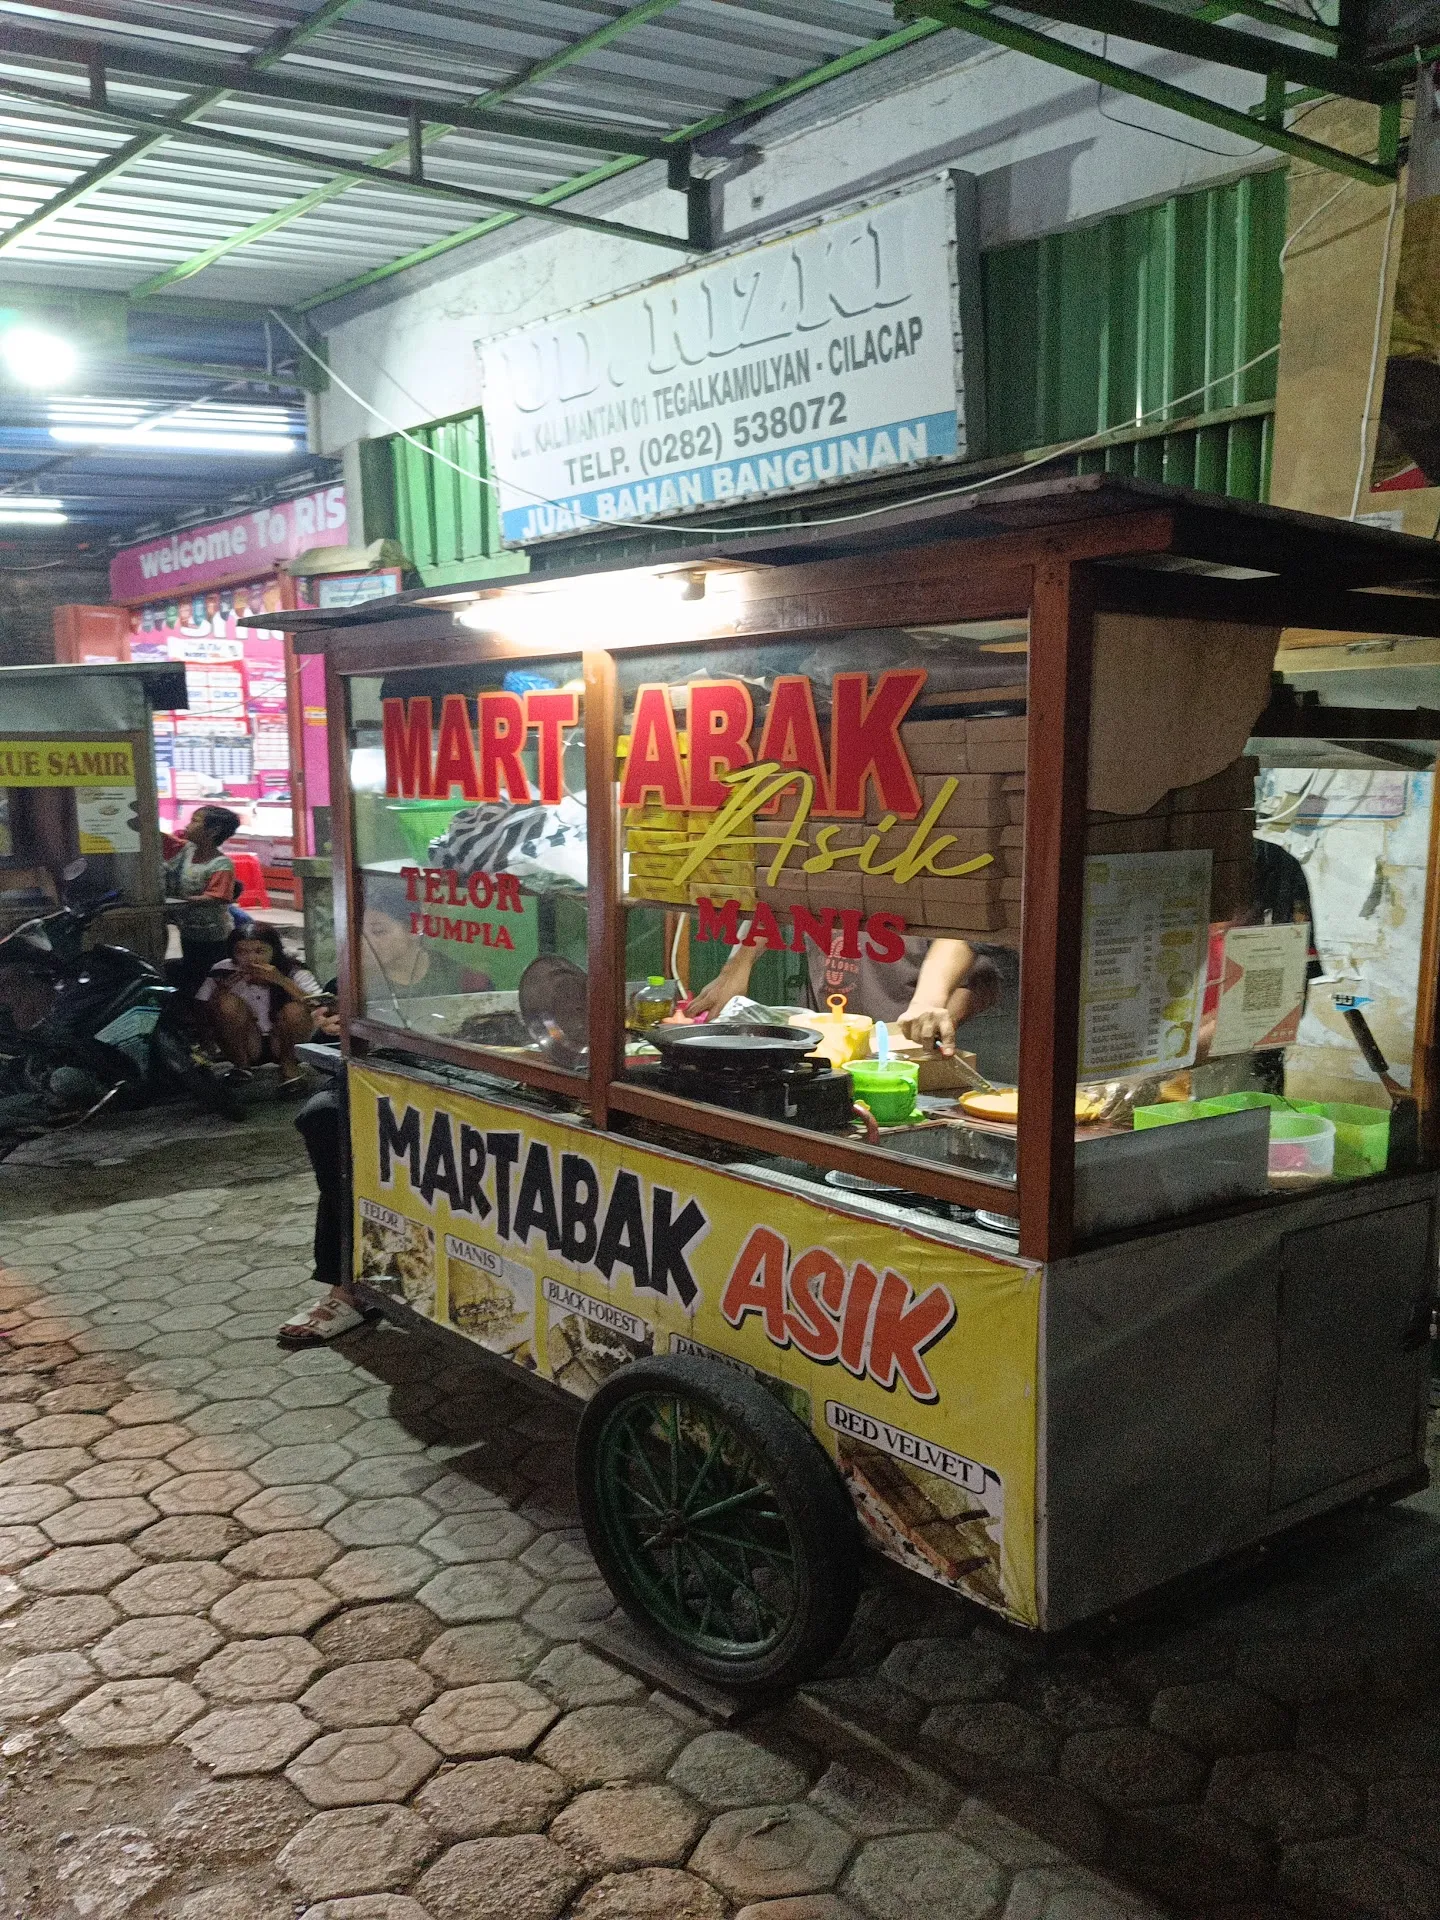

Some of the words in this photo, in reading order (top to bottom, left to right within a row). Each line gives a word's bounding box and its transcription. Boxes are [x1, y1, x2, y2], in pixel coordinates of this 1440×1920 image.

[652, 347, 811, 421] TEGALKAMULYAN
[828, 316, 923, 376] CILACAP
[564, 446, 630, 486] TELP.
[639, 422, 723, 476] (0282)
[733, 391, 847, 448] 538072
[522, 500, 590, 538] JUAL
[597, 473, 705, 522] BAHAN
[711, 422, 929, 500] BANGUNAN
[252, 508, 287, 548] To
[0, 750, 41, 777] UE
[47, 750, 131, 777] SAMIR
[658, 761, 995, 888] Asik
[399, 866, 524, 914] TELOR
[696, 897, 906, 964] MANIS
[363, 1201, 399, 1228] TELOR
[375, 1095, 708, 1308] MARTABAK
[720, 1222, 958, 1401] ASIK
[449, 1238, 496, 1270] MANIS
[549, 1282, 586, 1315] BLACK
[587, 1303, 639, 1335] FOREST
[834, 1405, 879, 1441] RED
[883, 1427, 974, 1483] VELVET
